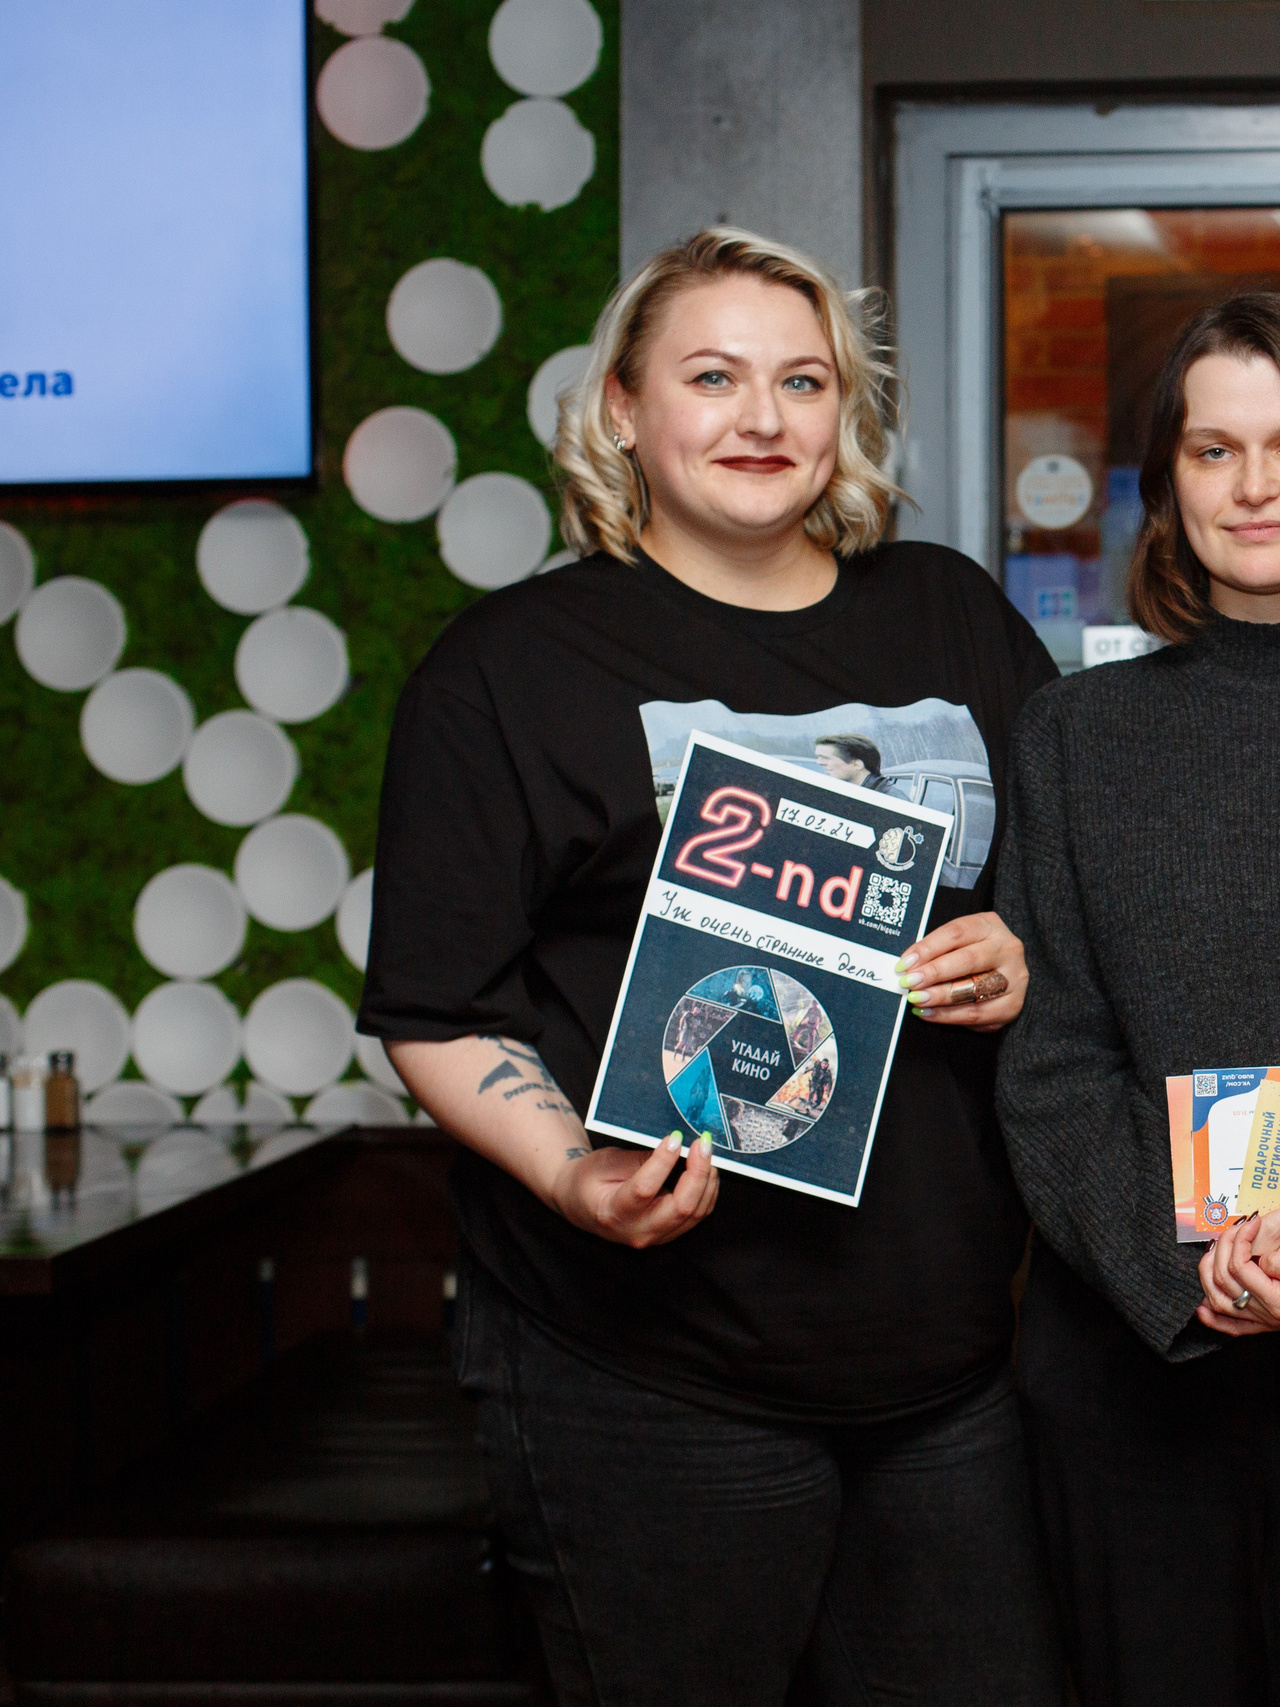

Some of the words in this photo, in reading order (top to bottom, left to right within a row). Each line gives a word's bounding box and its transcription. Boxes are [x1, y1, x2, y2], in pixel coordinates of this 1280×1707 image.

[675, 786, 863, 922] 2-nd
[660, 890, 692, 923] Уж
[700, 915, 752, 943] очень
[732, 1039, 781, 1067] УГАДАЙ
[732, 1058, 770, 1081] КИНО
[1251, 1111, 1276, 1189] ПОДАРОЧНЫЙ
